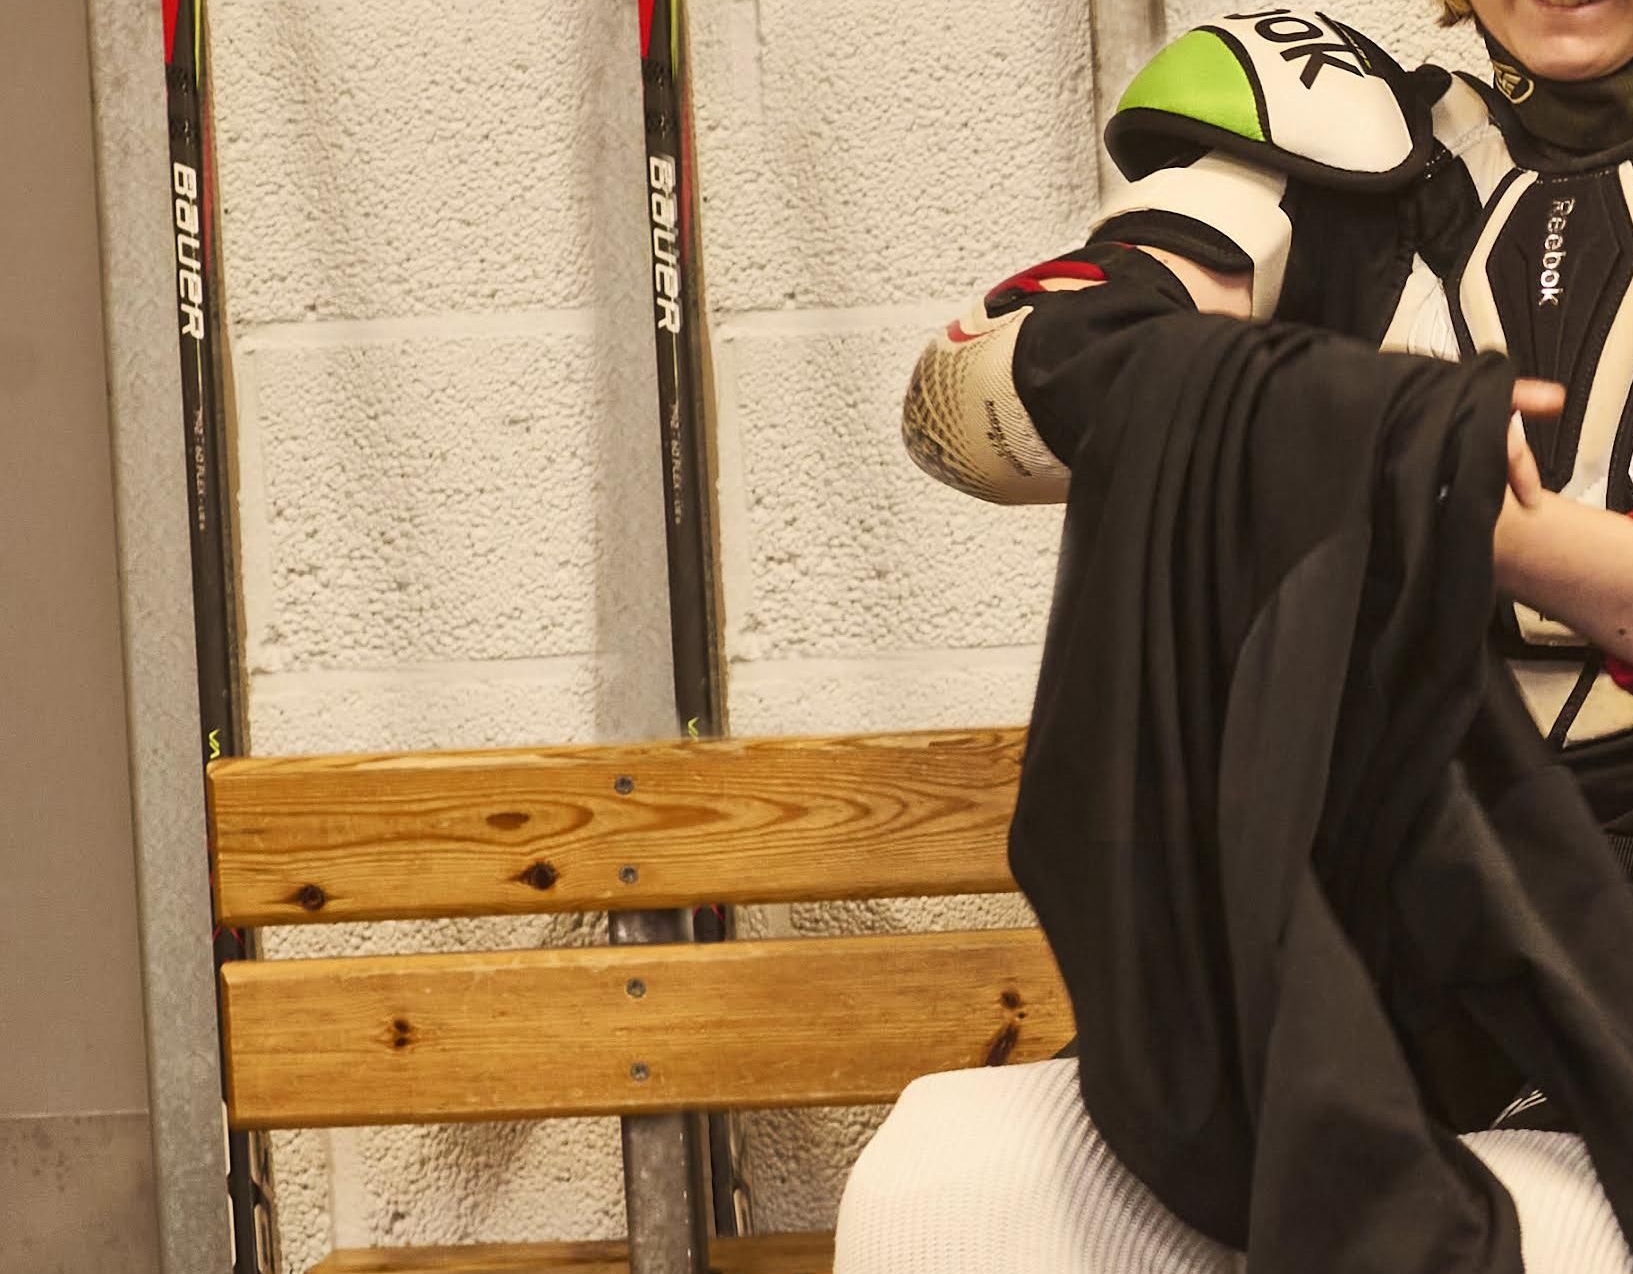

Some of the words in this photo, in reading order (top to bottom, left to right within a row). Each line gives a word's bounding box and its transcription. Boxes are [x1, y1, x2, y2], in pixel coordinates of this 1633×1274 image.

[1223, 8, 1365, 90] ok
[172, 161, 206, 341] BAUER
[647, 153, 682, 334] BAUER
[1537, 197, 1576, 307] Reebok
